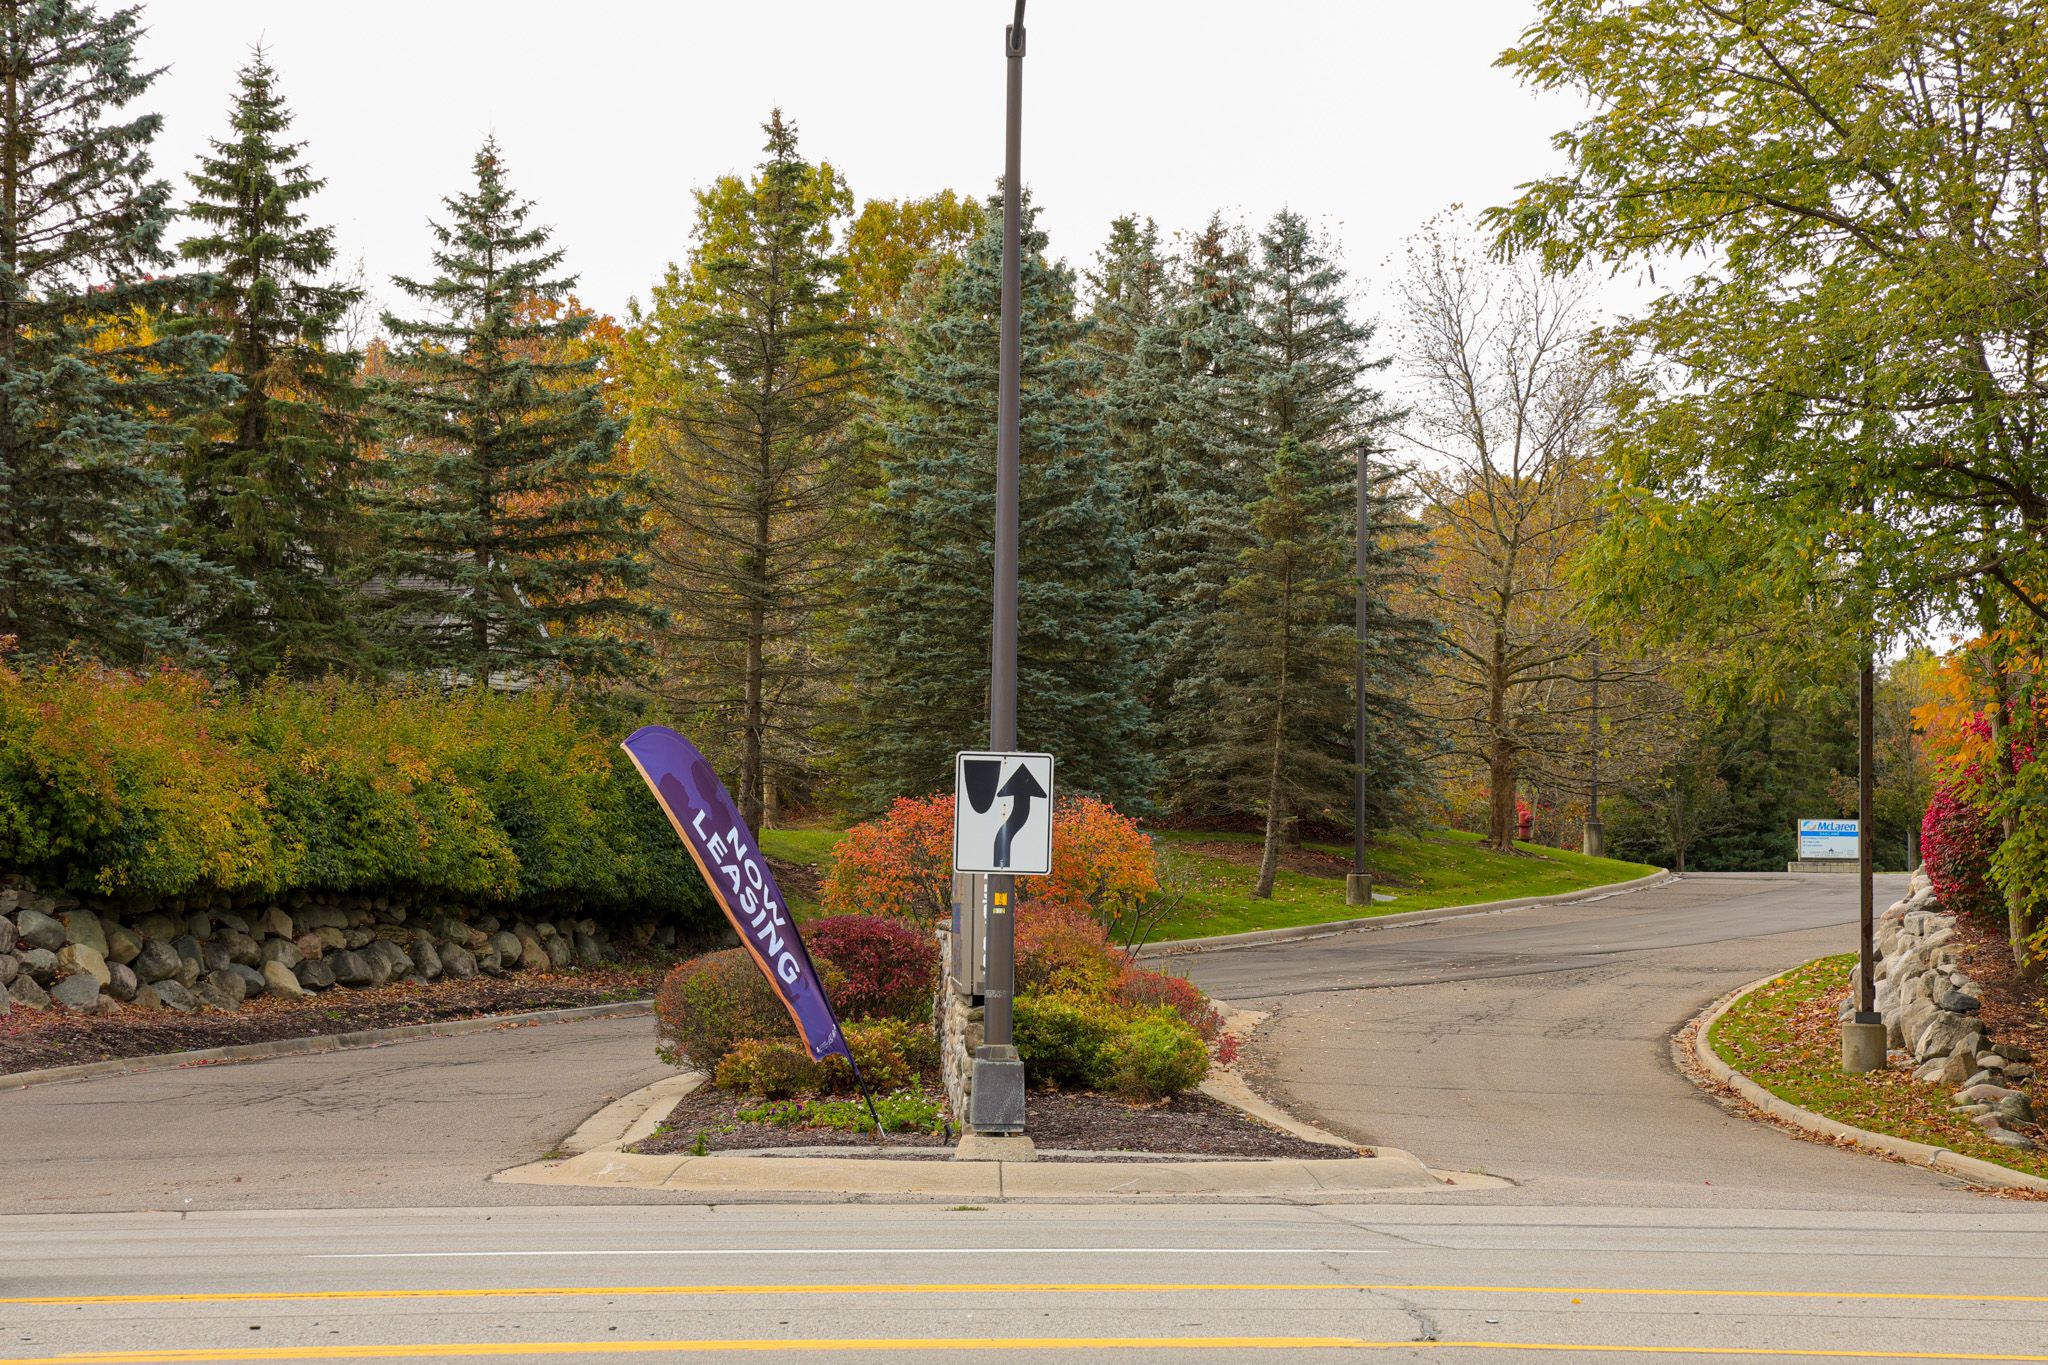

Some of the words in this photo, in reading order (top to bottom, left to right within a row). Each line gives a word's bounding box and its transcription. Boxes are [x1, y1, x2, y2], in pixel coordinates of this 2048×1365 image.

[727, 826, 785, 926] NOW
[1818, 822, 1856, 831] McLaren
[692, 809, 800, 985] LEASING
